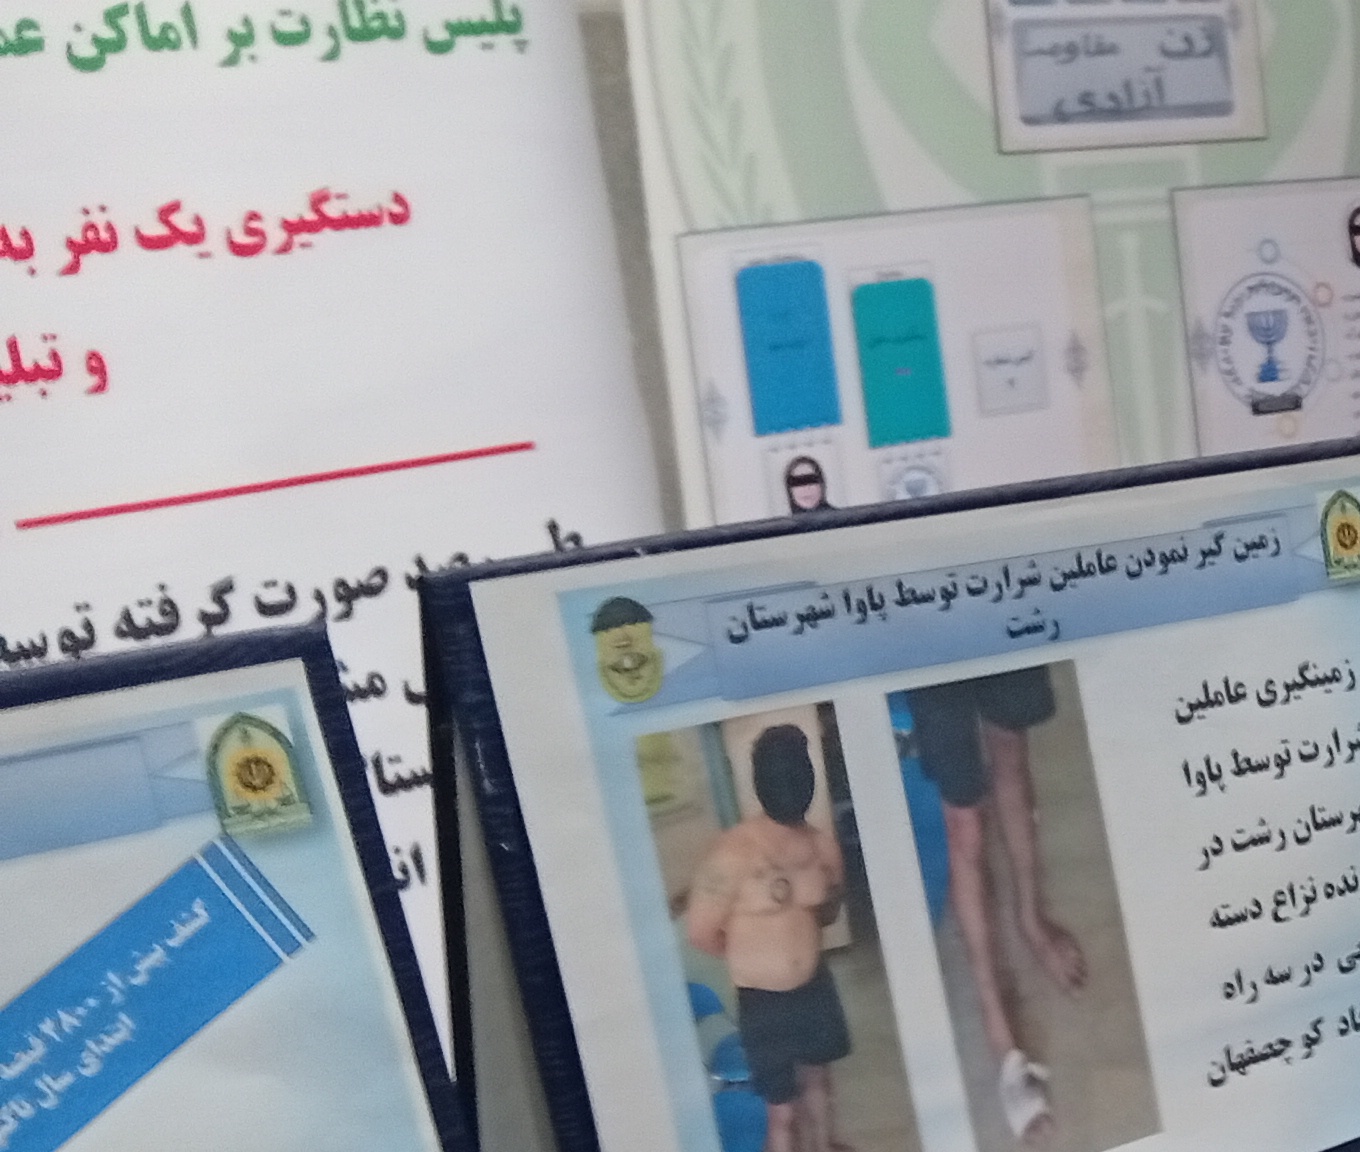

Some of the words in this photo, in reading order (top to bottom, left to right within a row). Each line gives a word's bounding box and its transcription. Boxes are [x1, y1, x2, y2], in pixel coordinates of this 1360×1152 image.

[66, 0, 197, 72] اماکن
[218, 14, 256, 68] بر
[58, 204, 119, 277] نفر
[134, 199, 213, 259] یک
[226, 187, 412, 257] دستگیری
[85, 349, 109, 395] و
[1124, 534, 1189, 580] نمودن
[1195, 530, 1226, 570] گیر
[1232, 527, 1281, 562] زمین
[894, 572, 959, 613] توسط
[965, 558, 1043, 604] شرارت
[1049, 548, 1118, 593] عاملین
[726, 590, 836, 645] شهرستان
[1006, 606, 1061, 641] رشت
[1173, 674, 1249, 726] عاملین
[1255, 658, 1358, 708] زمینگیری
[1229, 738, 1293, 780] توسط
[1197, 834, 1224, 871] در
[1230, 817, 1288, 853] رشت
[1208, 897, 1264, 931] دسته
[1271, 876, 1318, 924] نزاع
[100, 970, 128, 1005] از
[1221, 968, 1260, 1004] راه
[1262, 963, 1293, 988] سه
[1297, 950, 1326, 989] در
